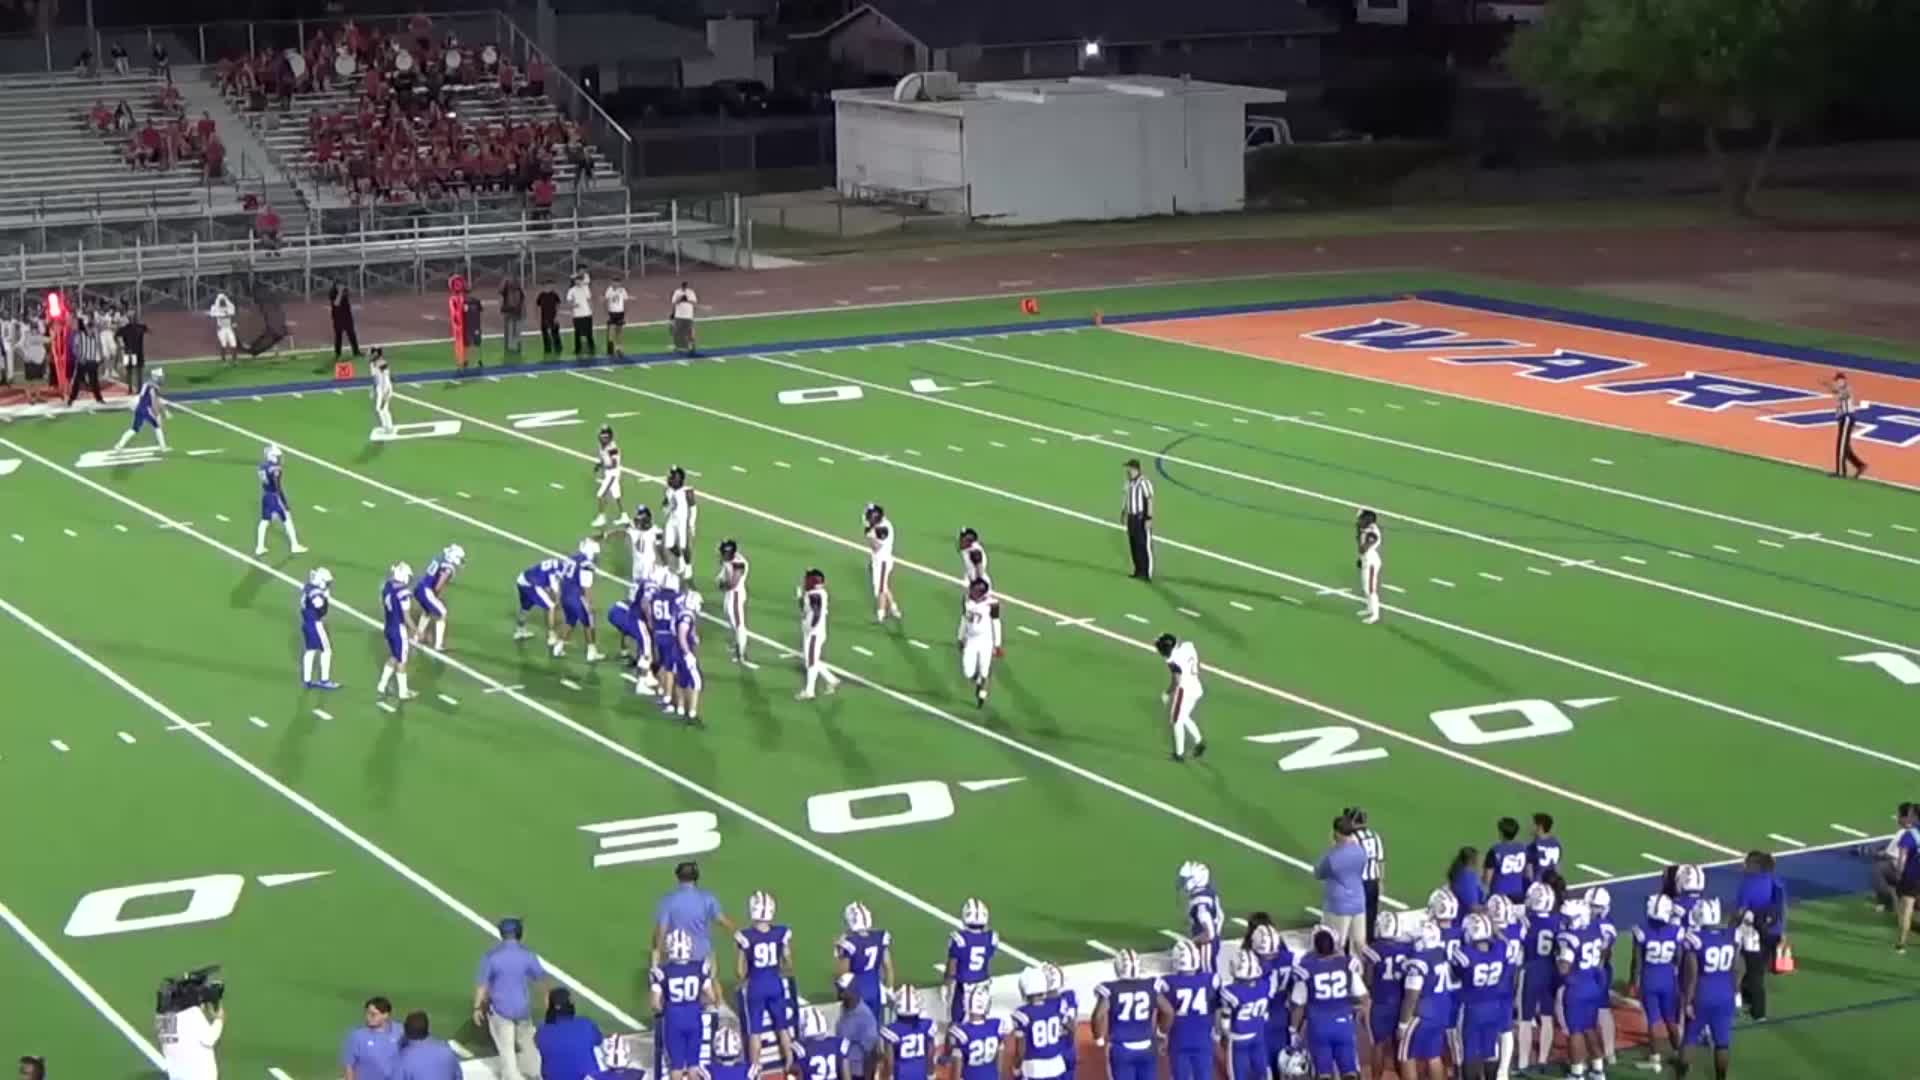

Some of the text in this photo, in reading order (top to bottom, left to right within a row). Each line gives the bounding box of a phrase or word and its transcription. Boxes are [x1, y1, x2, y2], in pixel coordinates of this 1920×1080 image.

[653, 600, 672, 620] 61
[754, 942, 778, 968] 91
[1537, 929, 1554, 956] 6
[1646, 940, 1676, 964] 26
[864, 946, 878, 971] 7
[969, 946, 986, 971] 5
[1704, 944, 1734, 973] 90
[1314, 970, 1347, 999] 52
[1473, 961, 1503, 987] 62
[668, 977, 699, 1002] 50
[1176, 988, 1209, 1016] 74
[1118, 991, 1150, 1021] 72
[1031, 1016, 1061, 1048] 80
[900, 1033, 926, 1059] 21
[968, 1036, 998, 1067] 28
[809, 1054, 838, 1080] 31
